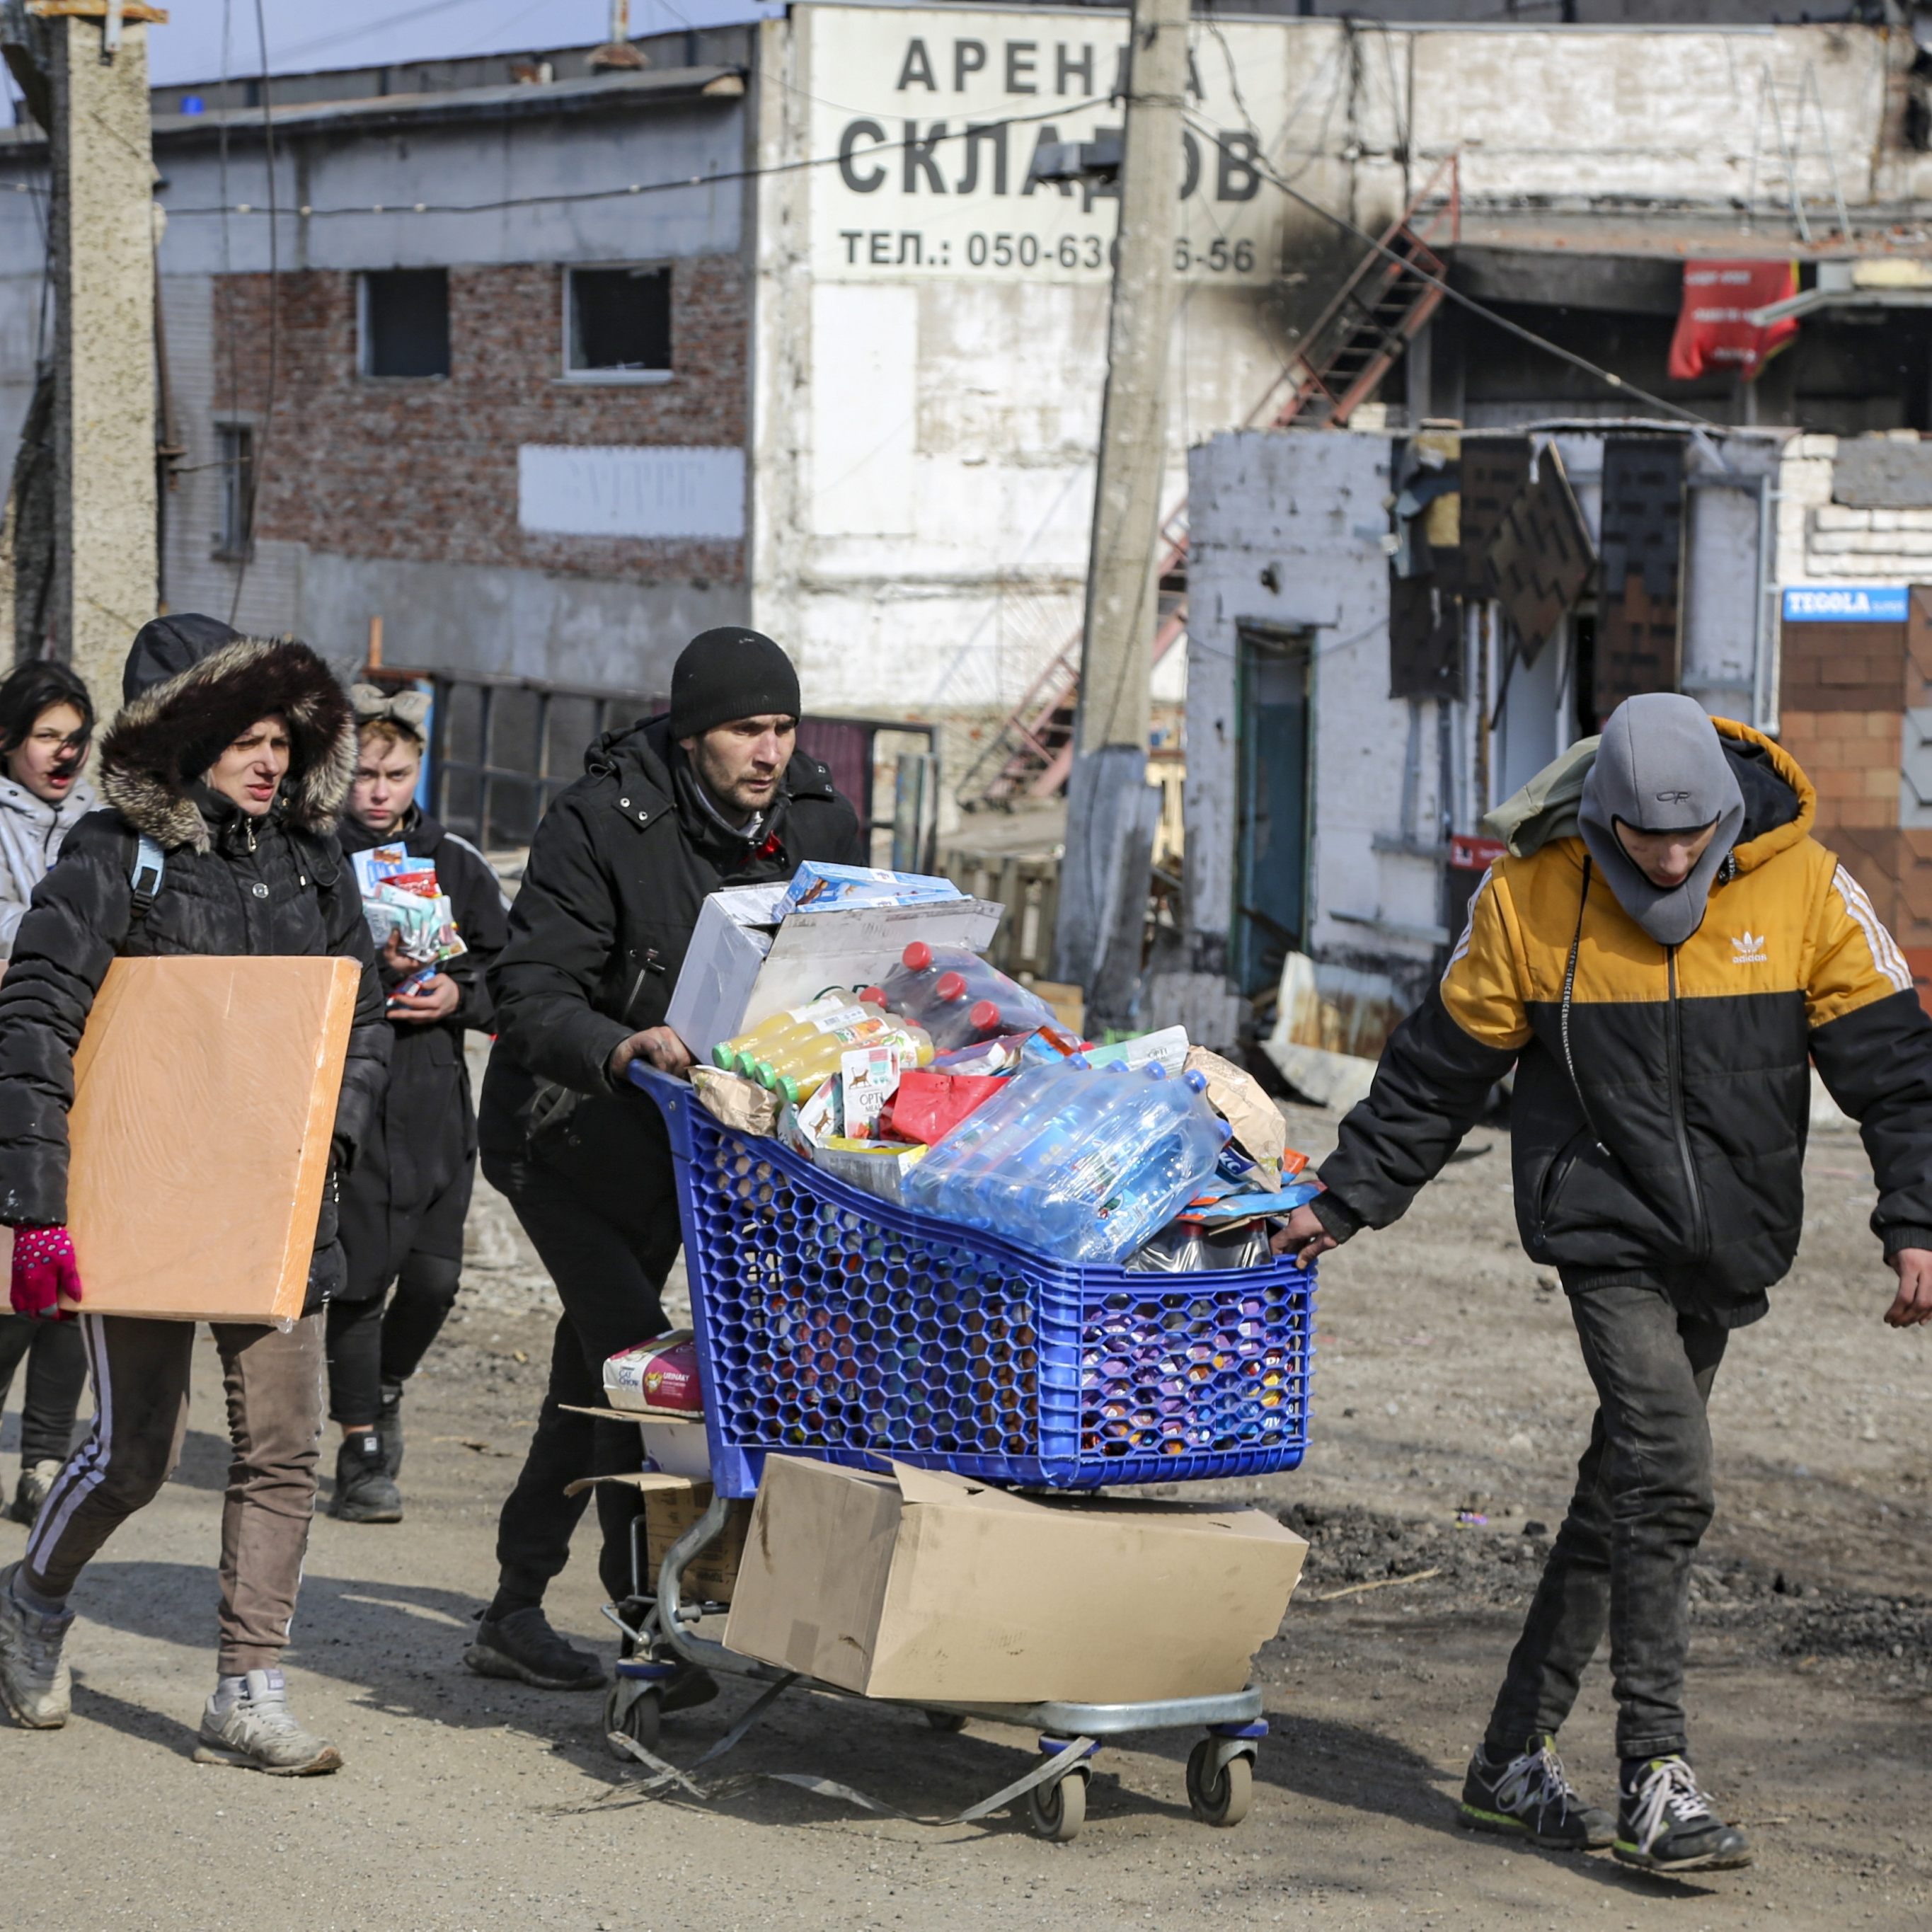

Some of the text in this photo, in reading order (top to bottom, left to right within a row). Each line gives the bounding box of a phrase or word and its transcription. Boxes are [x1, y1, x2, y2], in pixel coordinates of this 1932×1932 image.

[838, 119, 1262, 213] СКЛАВ
[840, 231, 1255, 273] ТЕЛ.: 050-636-56
[1732, 954, 1767, 963] adidas
